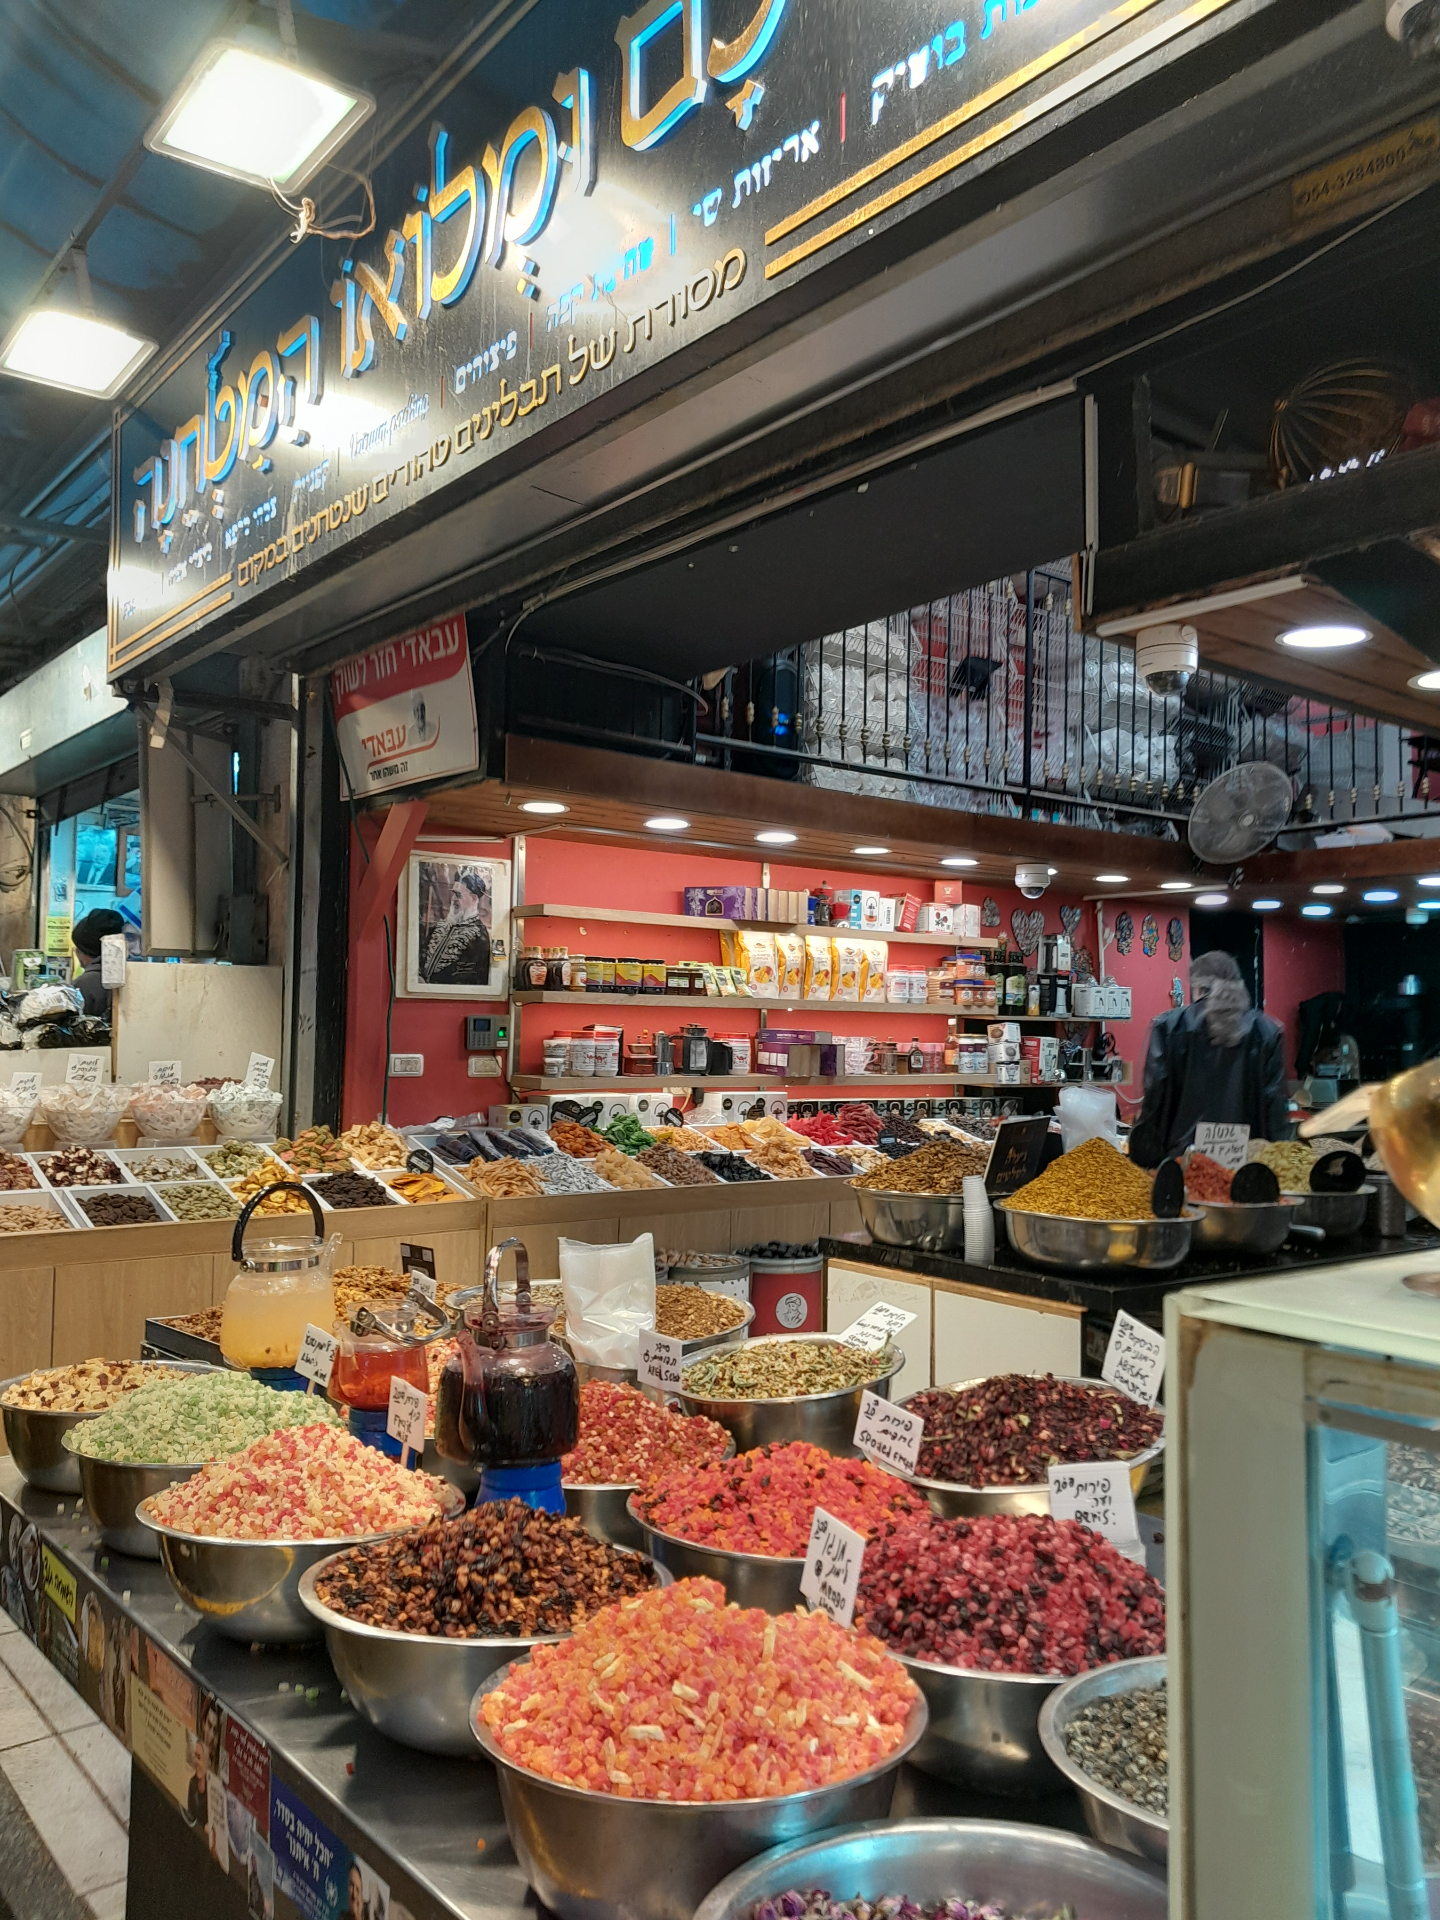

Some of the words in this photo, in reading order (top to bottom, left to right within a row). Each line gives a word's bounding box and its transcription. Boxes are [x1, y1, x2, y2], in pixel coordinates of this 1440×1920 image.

[732, 119, 821, 209] אריזות
[622, 247, 747, 354] מסורת
[455, 331, 518, 394] פיצוחים
[568, 327, 617, 386] של
[455, 363, 563, 448] תבלינים
[372, 433, 452, 505] טהורים
[293, 483, 369, 554] שנטחנים
[238, 536, 289, 587] במקום
[369, 644, 398, 682] חזר
[400, 621, 460, 669] עבאדי
[335, 657, 367, 705] לשוק
[1074, 1478, 1112, 1500] פירות
